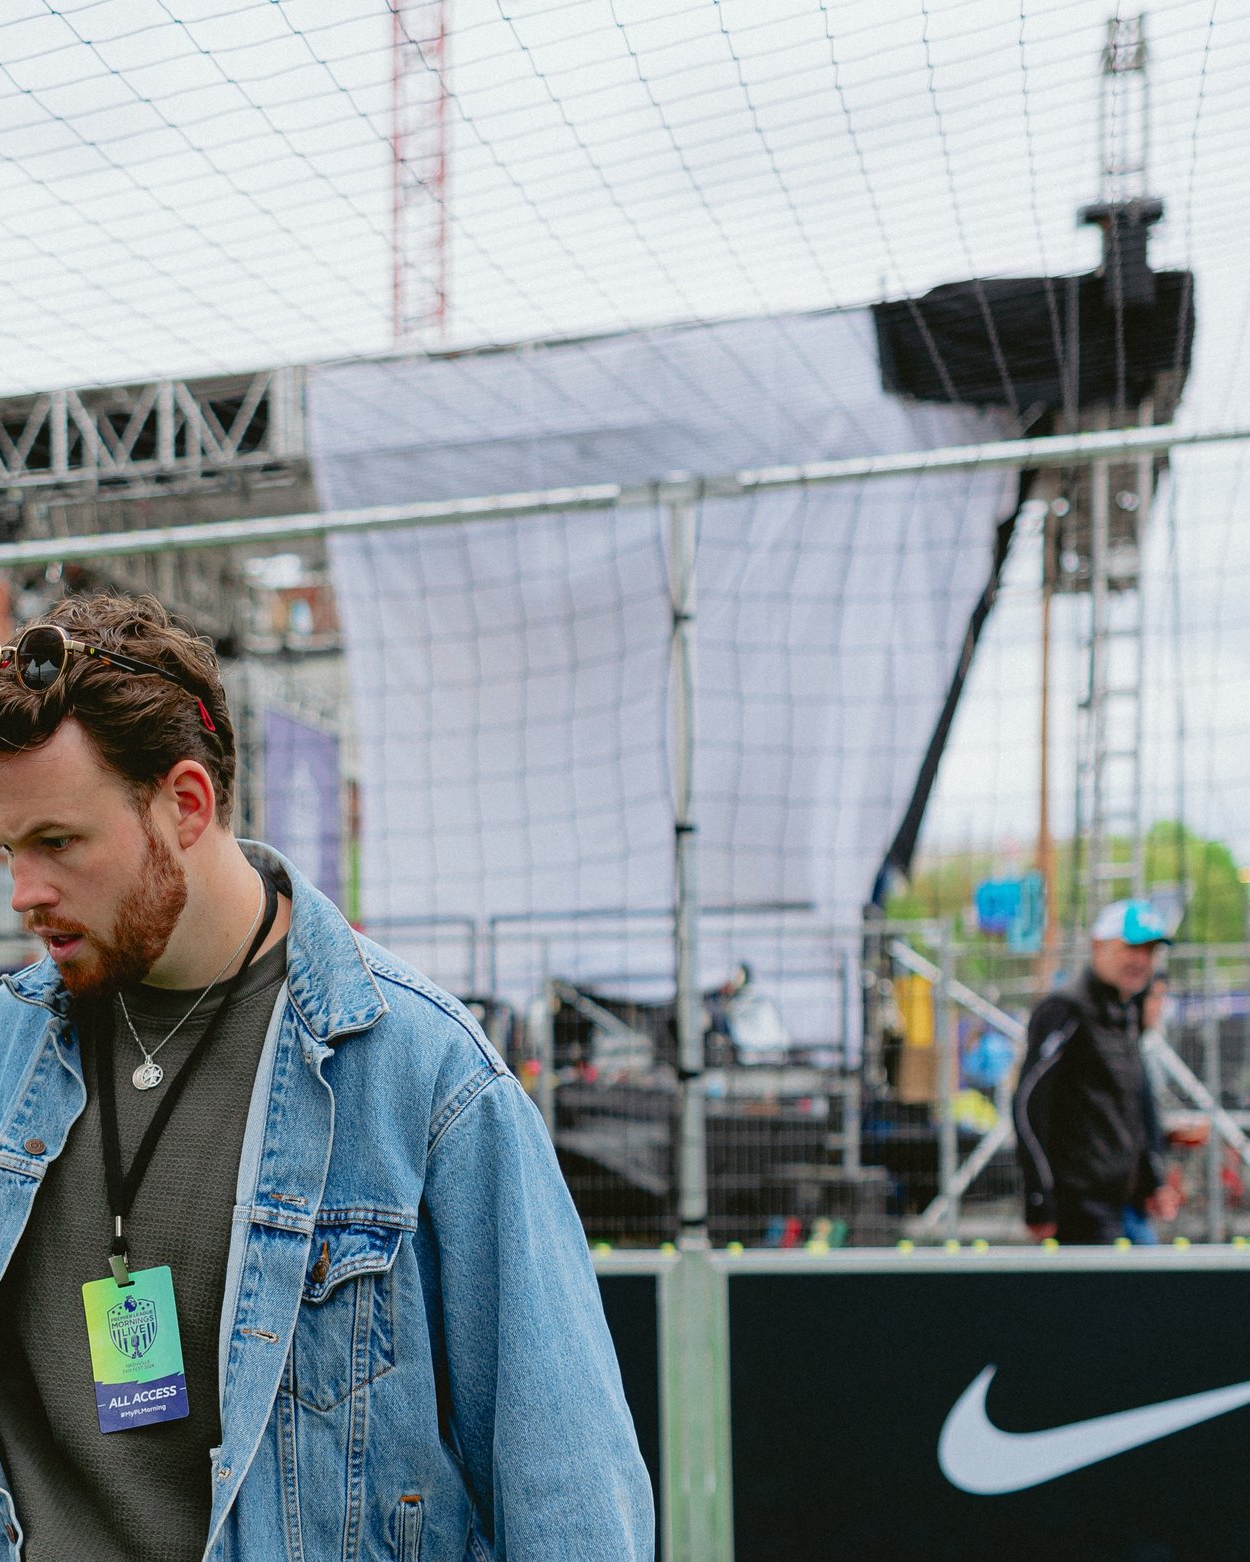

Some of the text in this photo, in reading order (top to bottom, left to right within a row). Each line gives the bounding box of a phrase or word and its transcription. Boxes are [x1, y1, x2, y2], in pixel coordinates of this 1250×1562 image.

[111, 1310, 154, 1323] PREMIER LEAGUE
[112, 1315, 154, 1330] MORNINGS
[122, 1324, 146, 1337] LIVE
[109, 1386, 177, 1409] ALL ACCESS
[120, 1404, 167, 1418] #MyPLMorning
